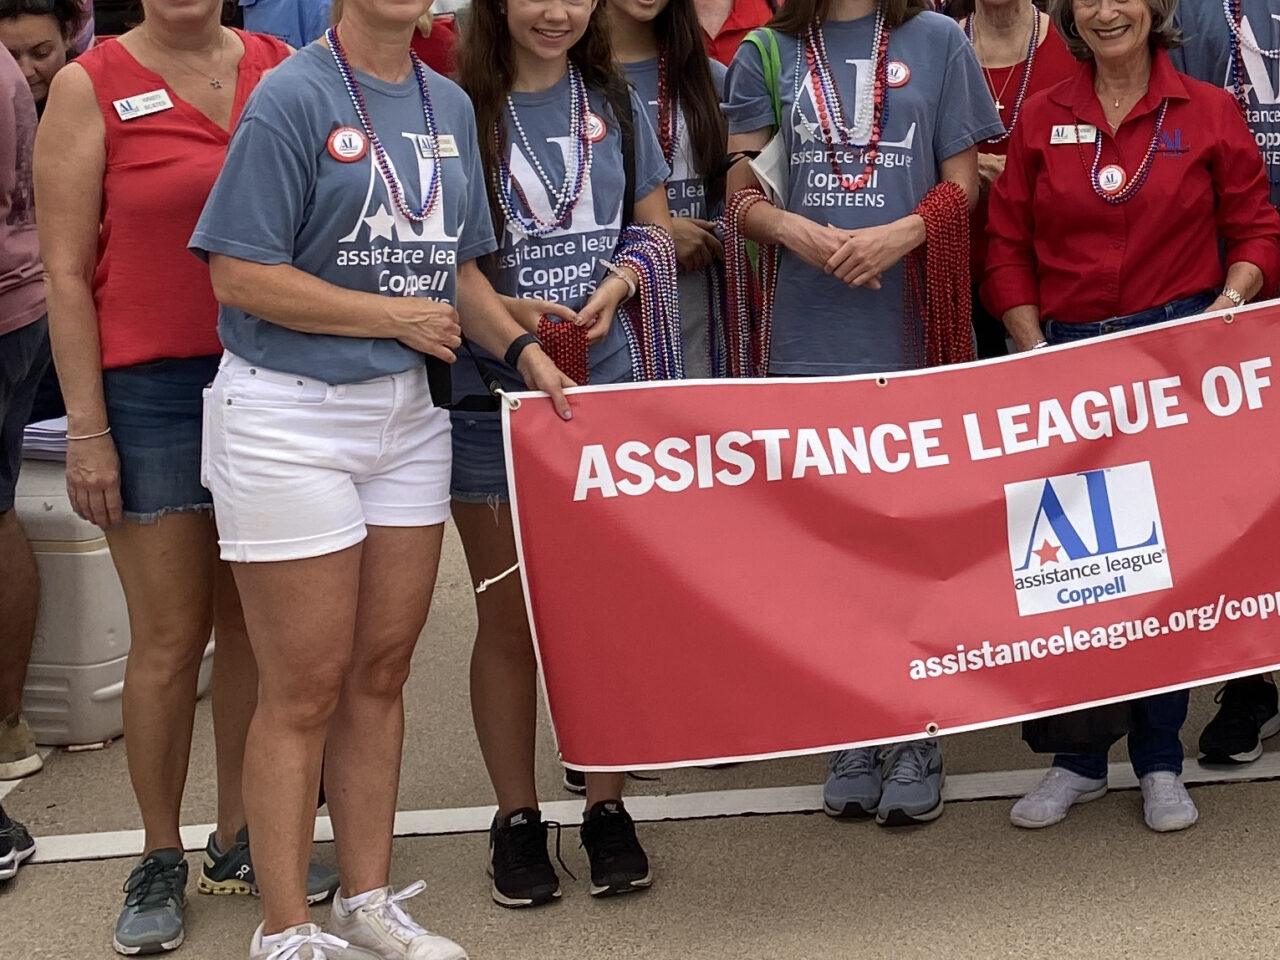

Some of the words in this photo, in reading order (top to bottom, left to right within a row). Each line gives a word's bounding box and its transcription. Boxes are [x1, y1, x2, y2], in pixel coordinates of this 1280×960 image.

[572, 418, 950, 502] ASSISTANCE
[962, 375, 1189, 462] LEAGUE
[1201, 356, 1273, 418] OF
[1014, 469, 1160, 571] AL
[1014, 559, 1101, 592] assistance
[1057, 575, 1127, 606] Coppell
